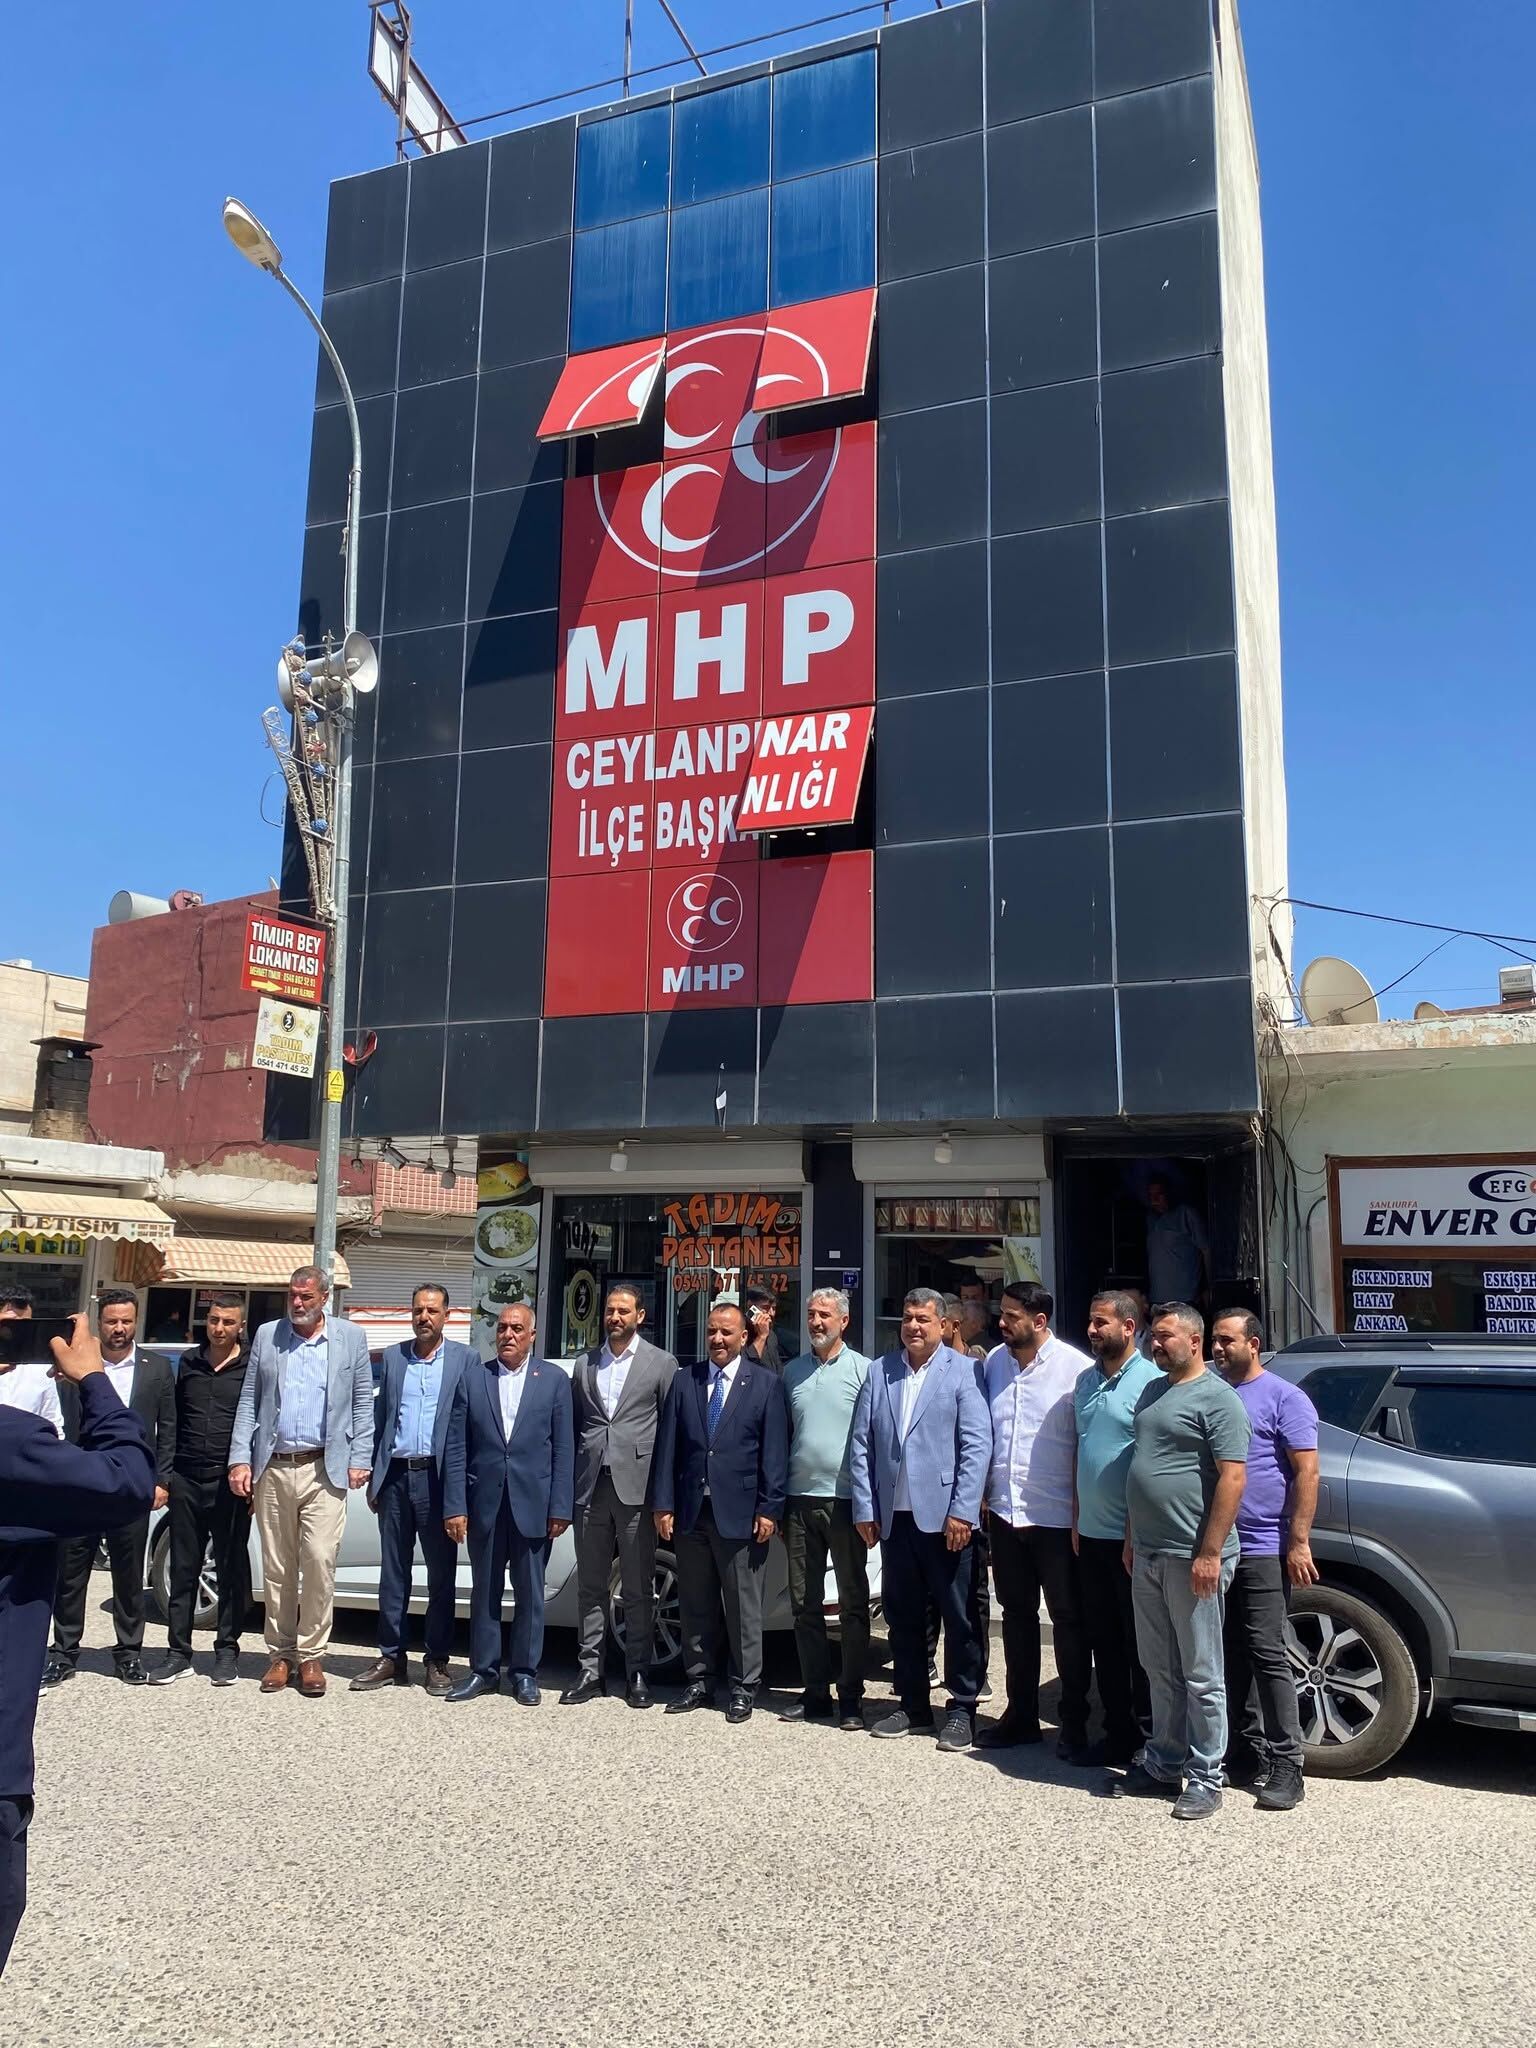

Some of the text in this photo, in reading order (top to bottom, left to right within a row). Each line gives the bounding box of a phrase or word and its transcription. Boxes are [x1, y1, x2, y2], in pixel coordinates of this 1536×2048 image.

[564, 588, 855, 715] MHP
[566, 712, 851, 790] CEYLANPNAR
[578, 759, 838, 867] İLÇE BAŞKNLIĞI
[251, 920, 321, 955] TİMUR BEY
[249, 944, 319, 976] LOKANTASI
[662, 962, 745, 993] MHP
[270, 1034, 303, 1051] TADIM
[257, 1058, 309, 1074] 0541 471 45 22
[1489, 1180, 1527, 1194] EFG
[10, 1215, 120, 1236] İLETİŞİM
[663, 1191, 782, 1235] TADIM
[1363, 1208, 1499, 1236] ENVER
[662, 1236, 800, 1272] PASTANESİ
[673, 1273, 708, 1292] 0541
[714, 1273, 740, 1292] 471
[770, 1273, 788, 1292] 22
[1352, 1269, 1432, 1288] İSKENDERUN
[1354, 1292, 1394, 1309] HATAY
[1355, 1314, 1408, 1332] ANKARA
